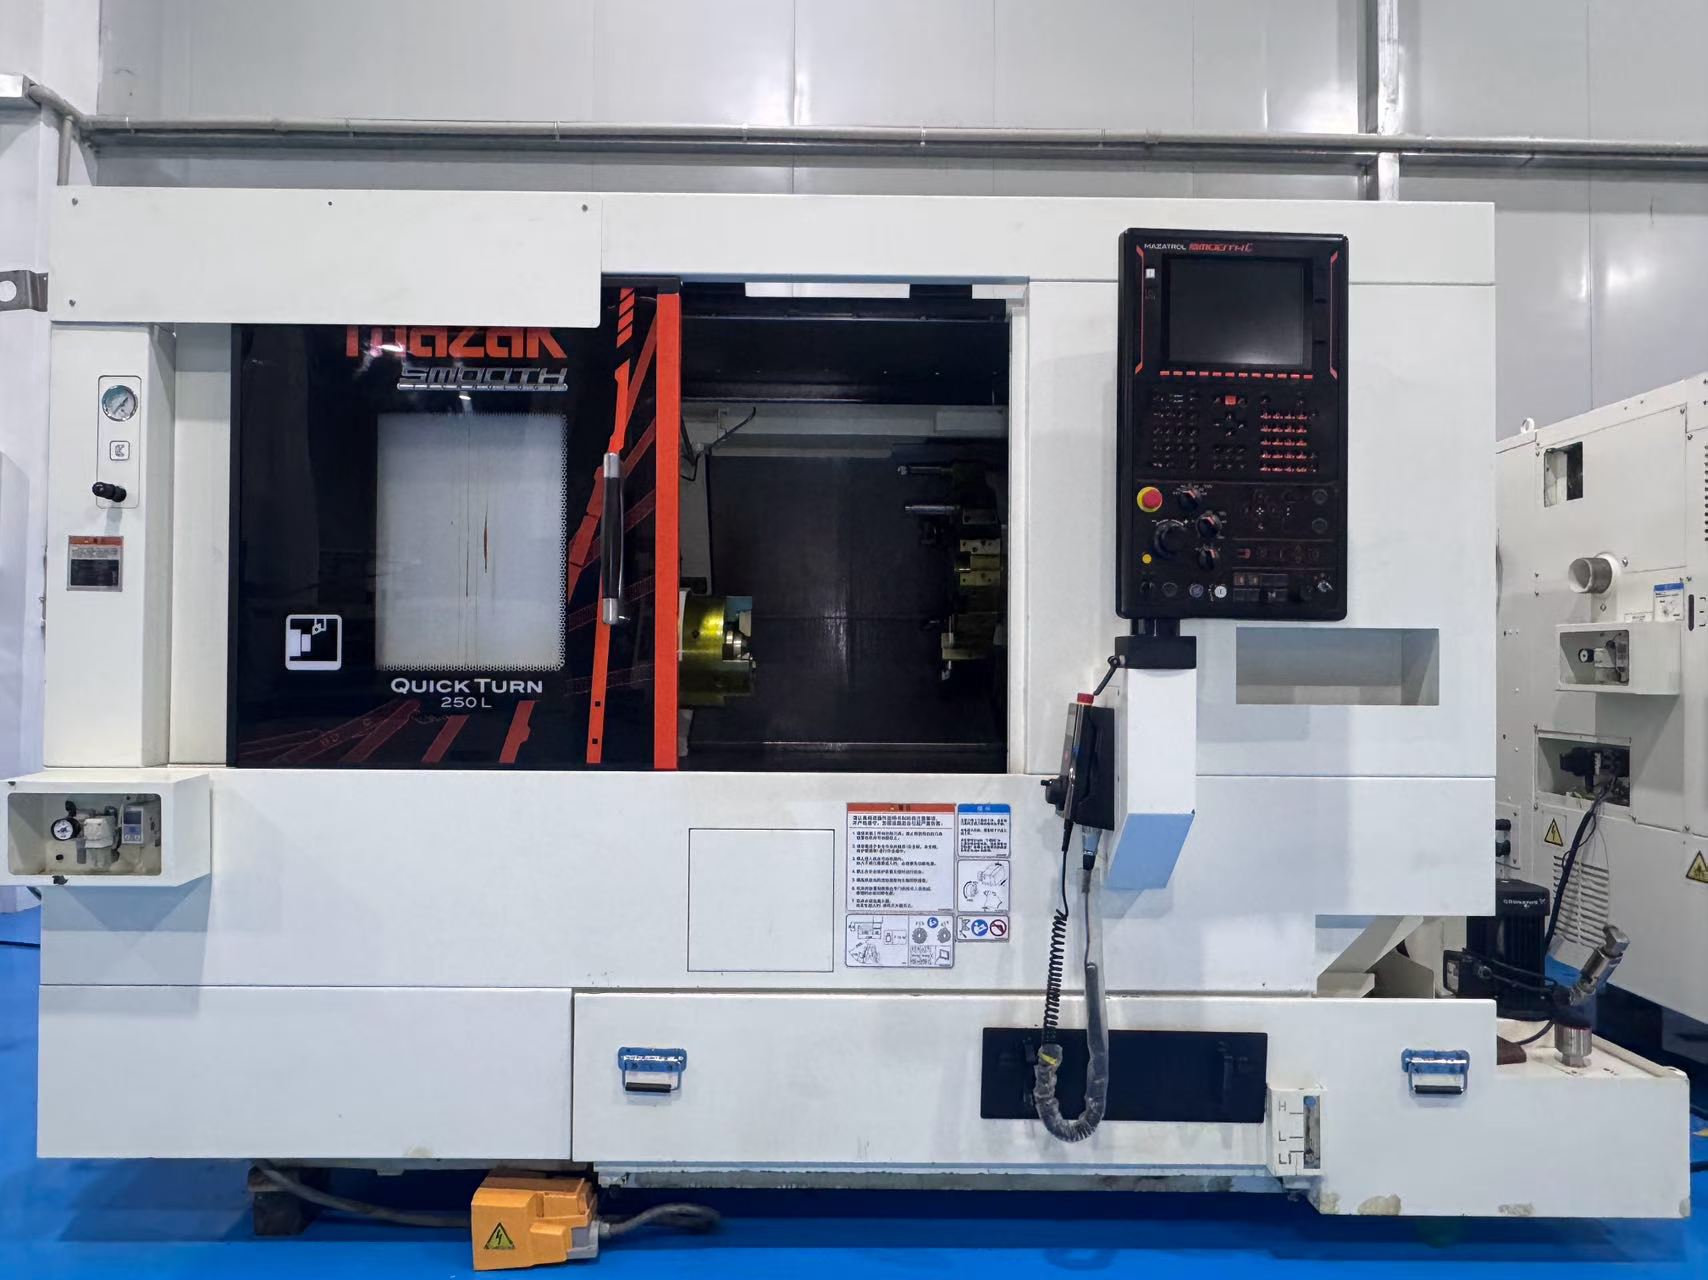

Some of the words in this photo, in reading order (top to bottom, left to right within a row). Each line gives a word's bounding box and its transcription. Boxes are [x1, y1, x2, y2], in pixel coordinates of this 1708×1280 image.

[400, 366, 568, 384] SMOOTH
[473, 678, 543, 694] TURN
[440, 696, 477, 709] 250
[481, 697, 492, 708] L
